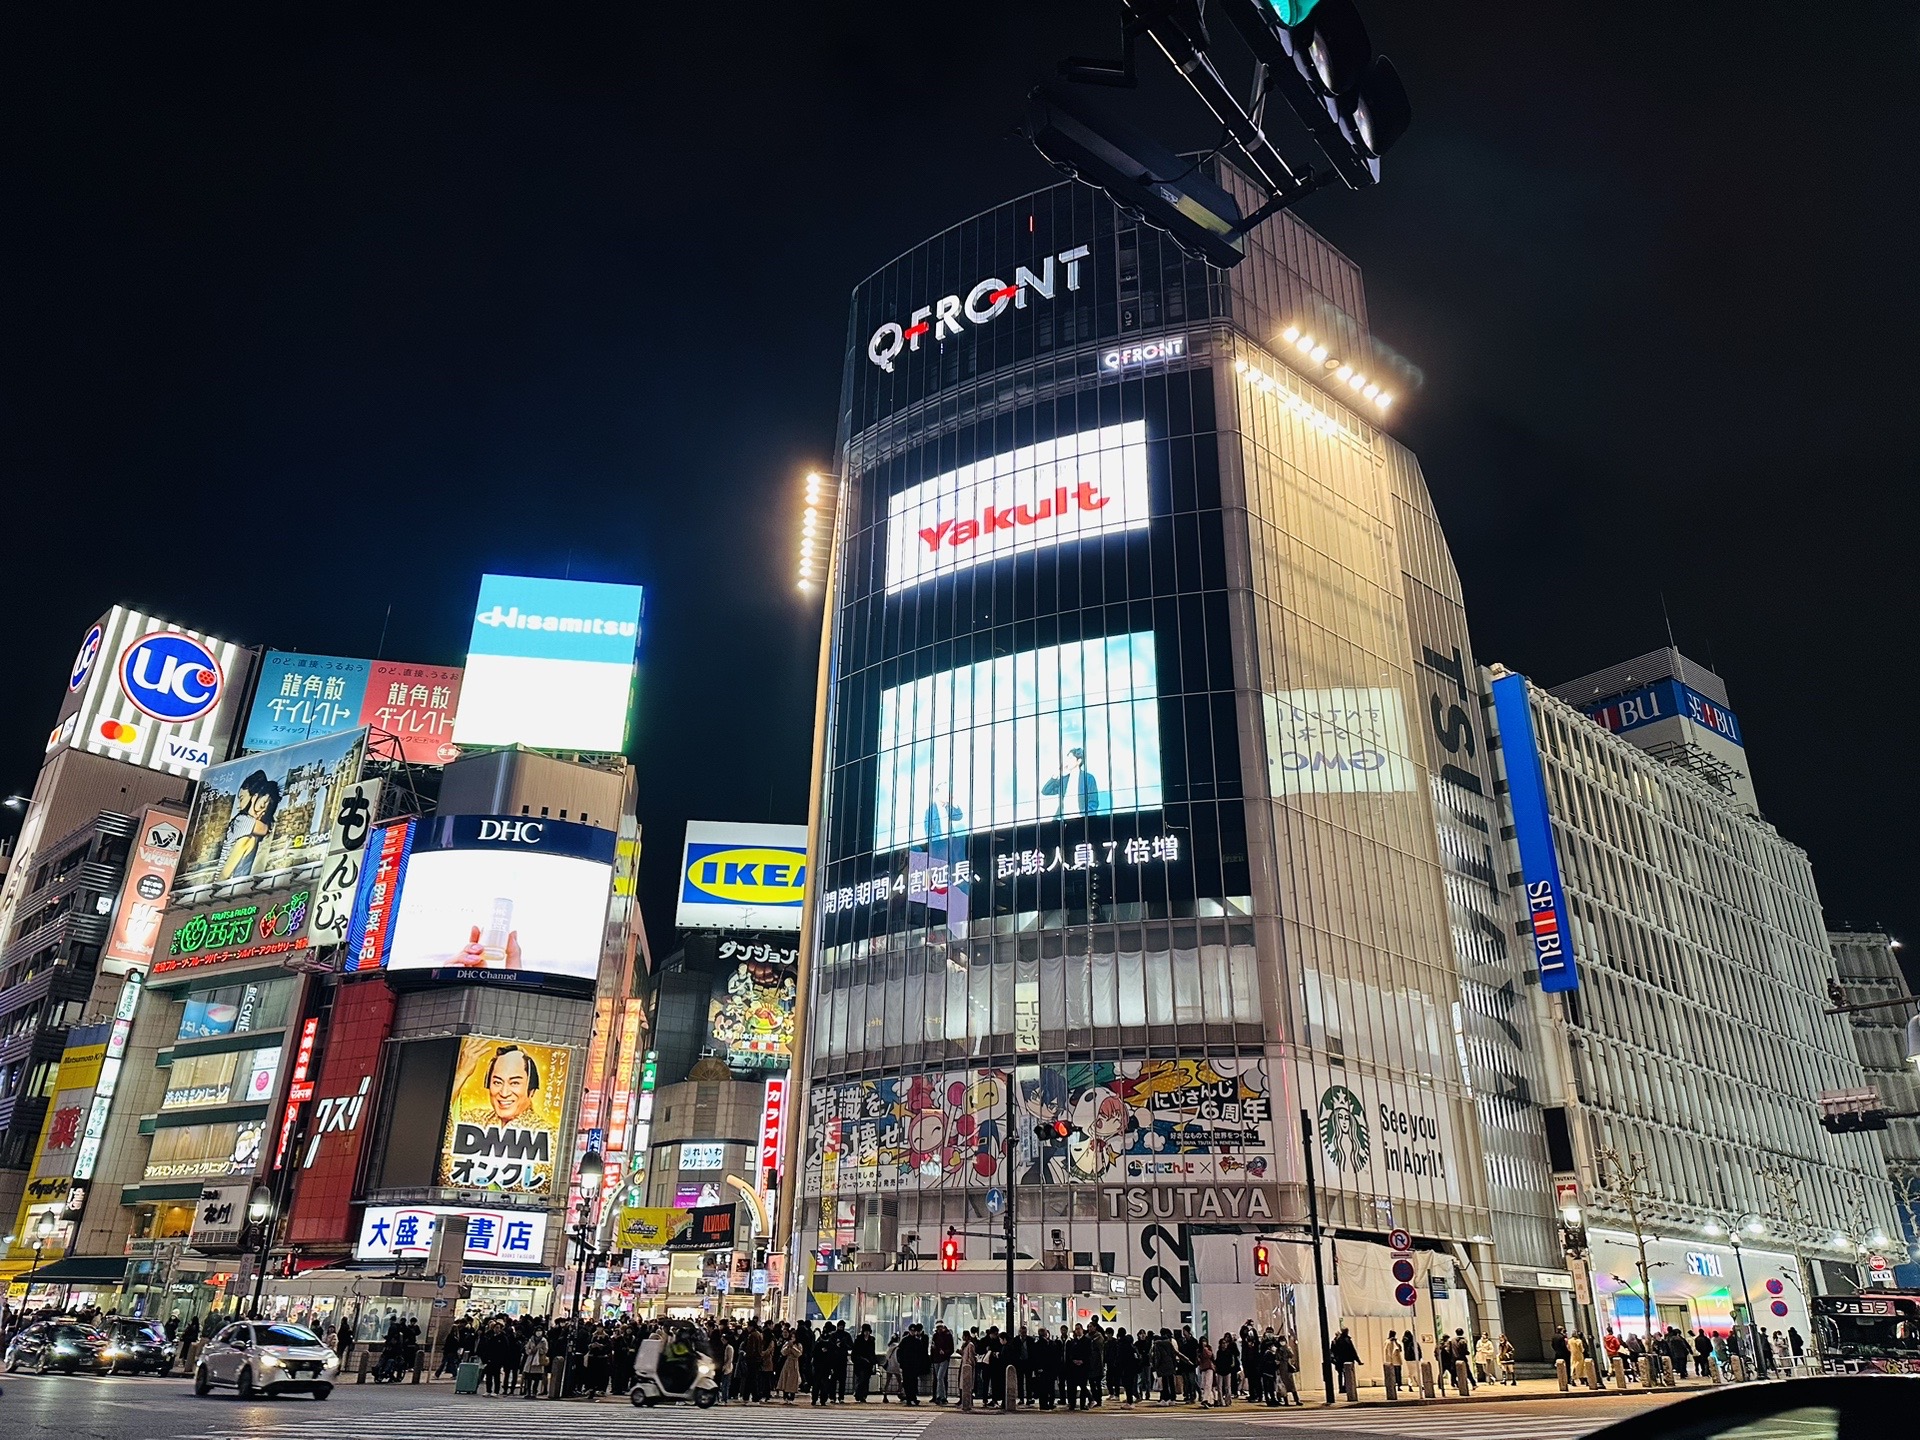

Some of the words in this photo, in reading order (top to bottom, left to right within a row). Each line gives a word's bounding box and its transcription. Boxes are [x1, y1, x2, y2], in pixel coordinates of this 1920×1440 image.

[868, 245, 1090, 373] QFRONT
[1105, 339, 1183, 369] QFRONT
[918, 481, 1111, 552] Yakult
[477, 606, 636, 637] Hisamitsu
[133, 646, 210, 704] UC
[272, 657, 364, 672] のど、直接、うるおう
[280, 672, 345, 700] 龍角散
[387, 682, 451, 709] 龍角散
[267, 698, 351, 727] ダイレクト
[374, 707, 455, 735] ダイレクト
[1687, 692, 1737, 740] SEIBU
[169, 742, 208, 766] VISA
[478, 820, 543, 844] DHC
[315, 786, 371, 940] もんじゃ
[205, 917, 255, 948] 西村
[1527, 880, 1565, 973] SEIBU
[718, 940, 800, 964] ダンジョン
[457, 970, 478, 979] DHC
[479, 971, 517, 981] Channel
[1154, 1080, 1234, 1108] にじさんじ
[763, 1089, 780, 1158] カラオケ
[1201, 1098, 1268, 1123] 6周年
[1380, 1103, 1408, 1135] See
[1410, 1114, 1437, 1142] you
[454, 1126, 549, 1162] DMM
[693, 1147, 722, 1156] れいわ
[450, 1158, 543, 1188] オンクレ
[682, 1159, 721, 1168] クリニック
[1145, 1162, 1195, 1174] にじさんじ
[1384, 1141, 1400, 1171] in
[1403, 1146, 1445, 1181] April!
[1104, 1187, 1273, 1218] TSUTAYA
[1835, 1301, 1888, 1314] ショコラ
